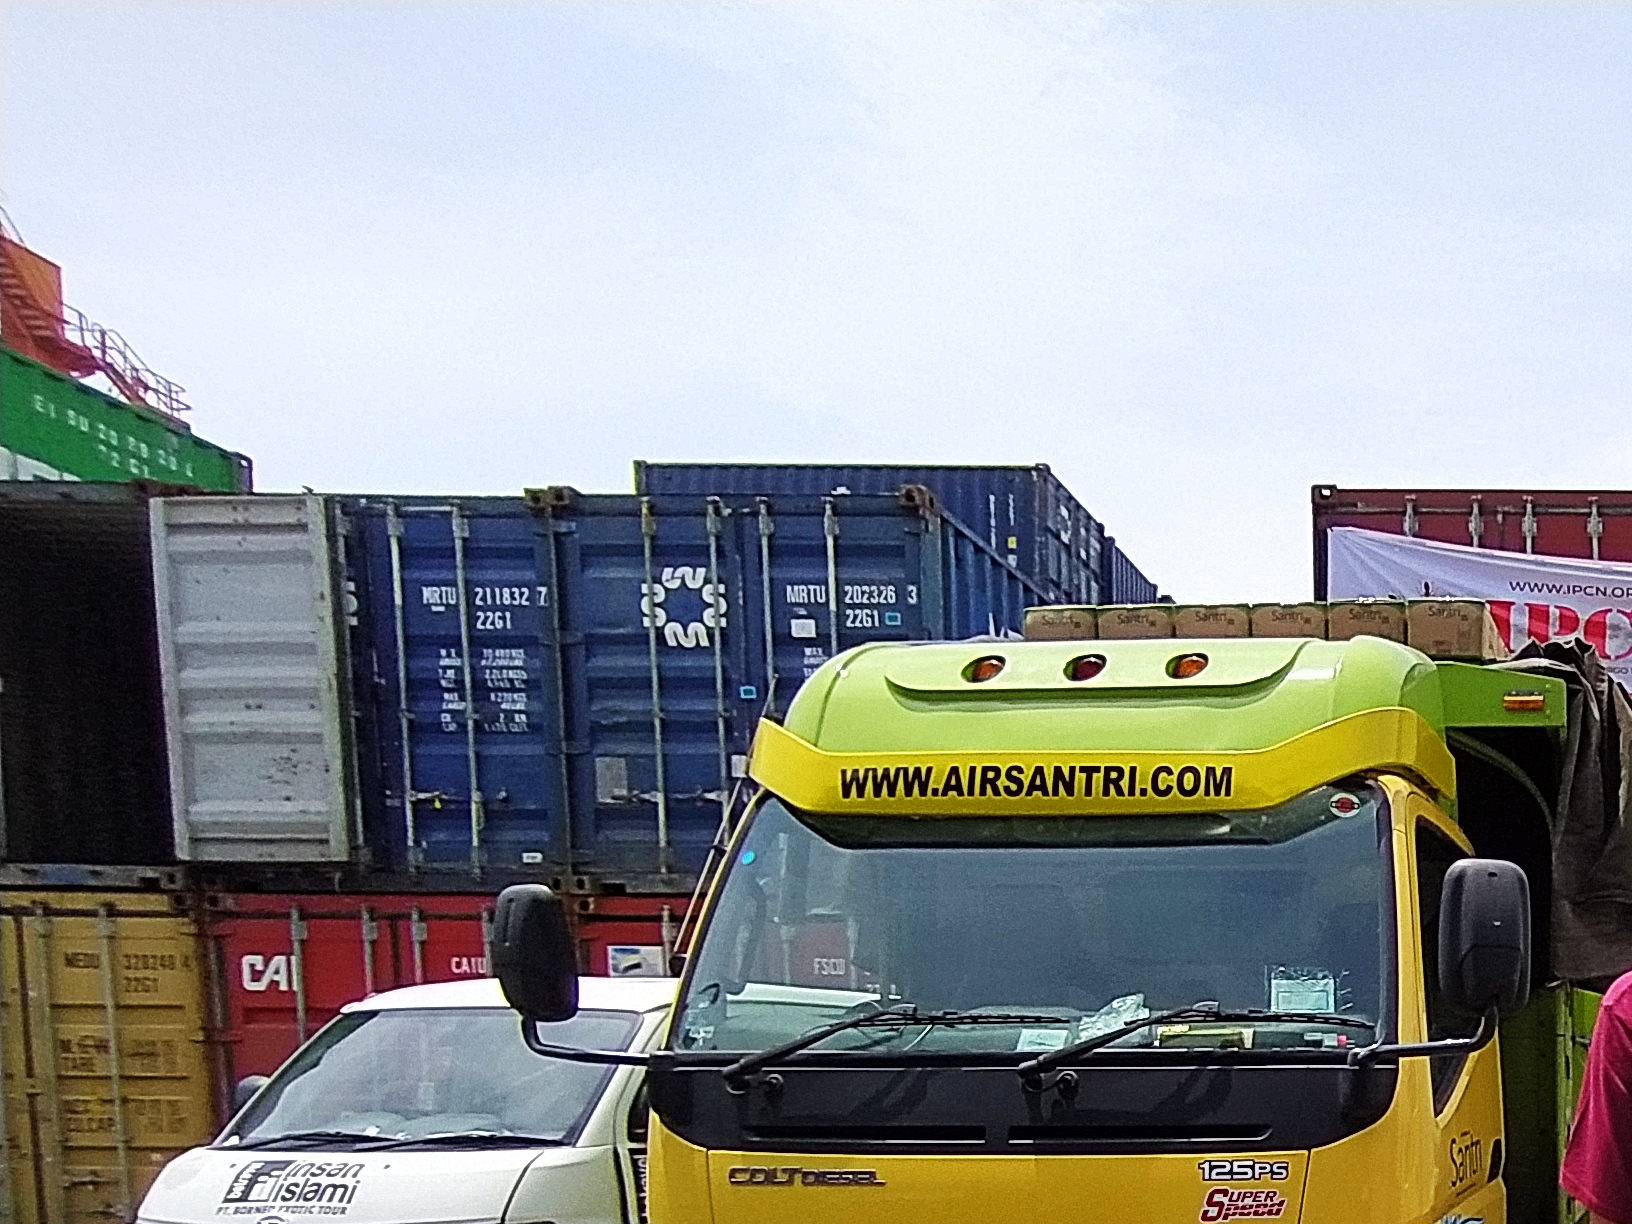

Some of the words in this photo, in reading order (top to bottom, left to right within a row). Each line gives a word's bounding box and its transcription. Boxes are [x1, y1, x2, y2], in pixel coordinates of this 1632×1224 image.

[421, 586, 457, 605] MRTU
[474, 587, 530, 606] 211832
[536, 586, 549, 606] 7
[786, 585, 827, 604] MRTU
[844, 586, 896, 604] 202326
[906, 585, 918, 605] 3
[476, 611, 512, 630] 22G1
[846, 609, 880, 628] 22G1
[840, 765, 1234, 799] WWW.AIRSANTRI.COM
[1198, 1159, 1290, 1181] 125PS
[271, 1178, 361, 1205] islami
